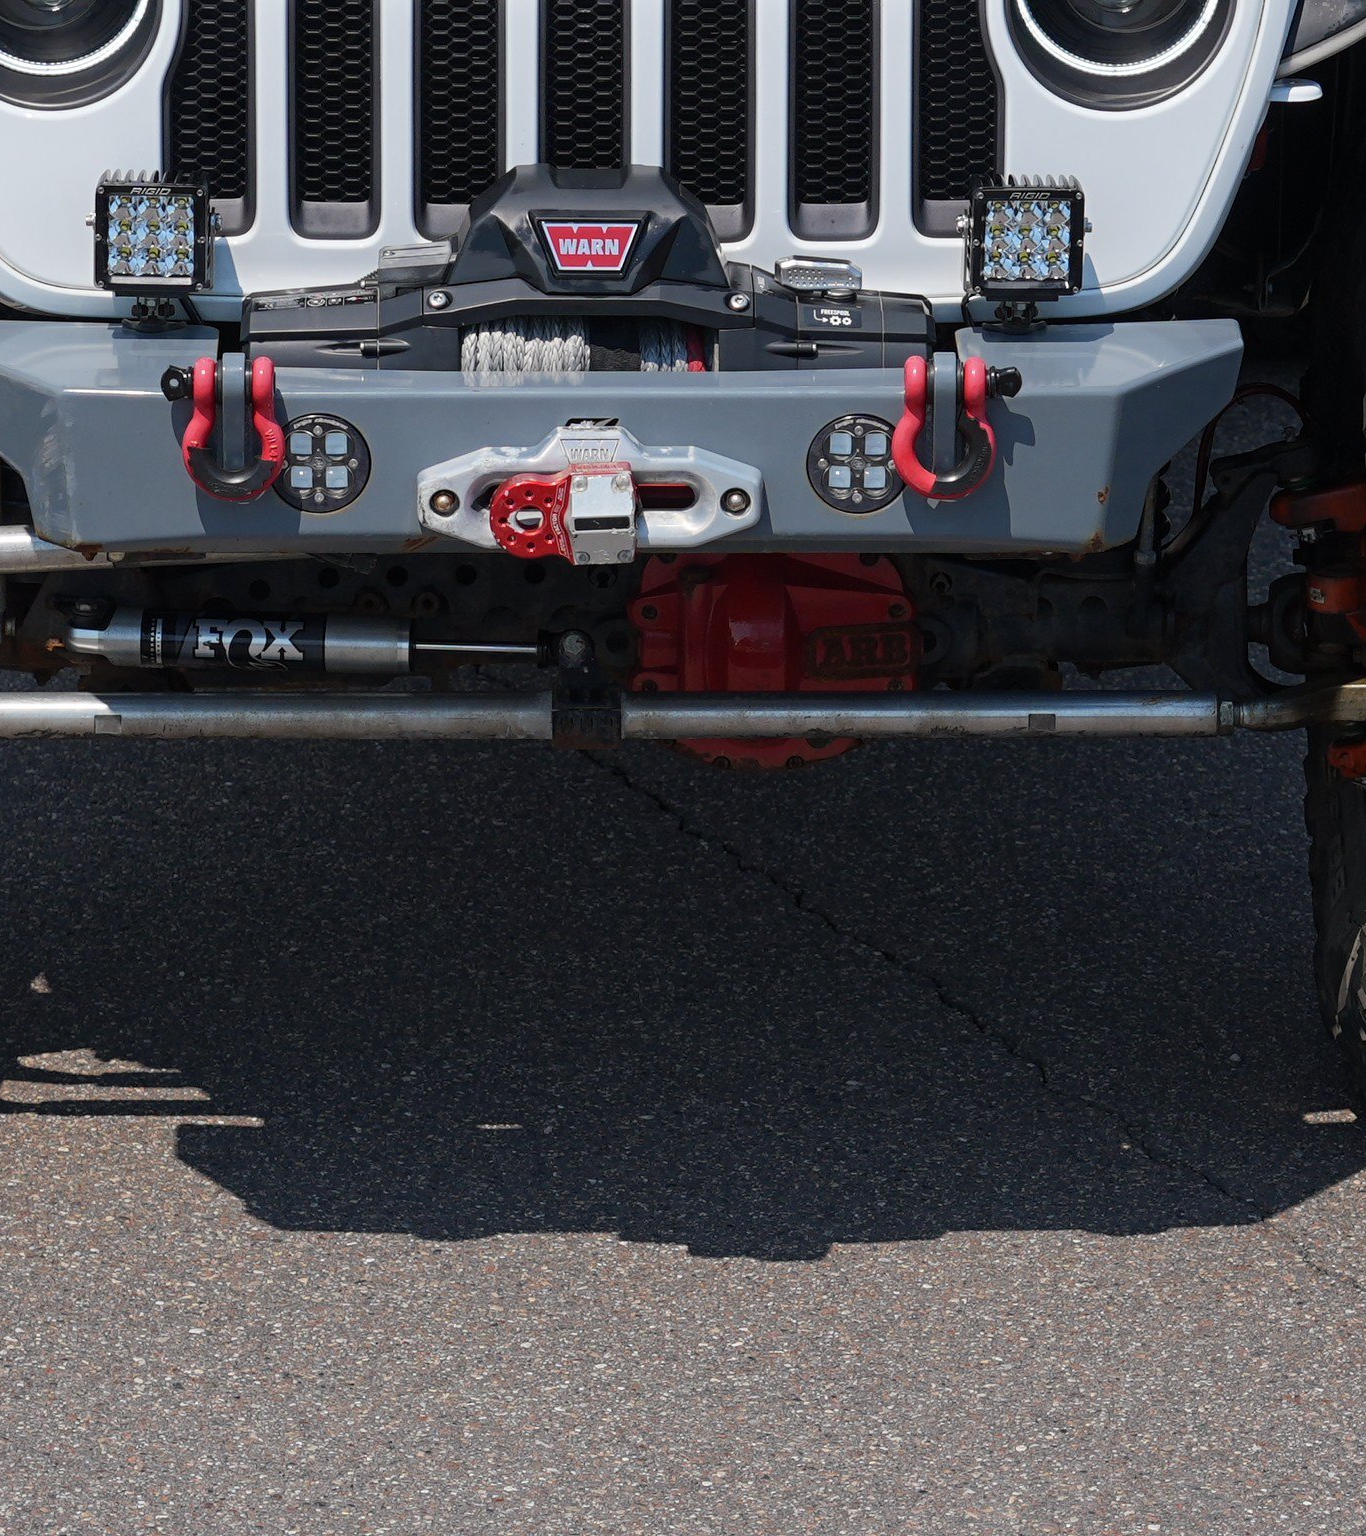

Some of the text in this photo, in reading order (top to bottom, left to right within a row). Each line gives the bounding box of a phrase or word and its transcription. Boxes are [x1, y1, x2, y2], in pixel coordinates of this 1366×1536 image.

[130, 187, 172, 195] RIGID
[1009, 192, 1051, 200] RIGID
[558, 238, 620, 256] WARN
[820, 308, 851, 317] FREESPOOL
[570, 448, 610, 461] WARN
[194, 618, 304, 668] FOX
[816, 632, 909, 667] ARB
